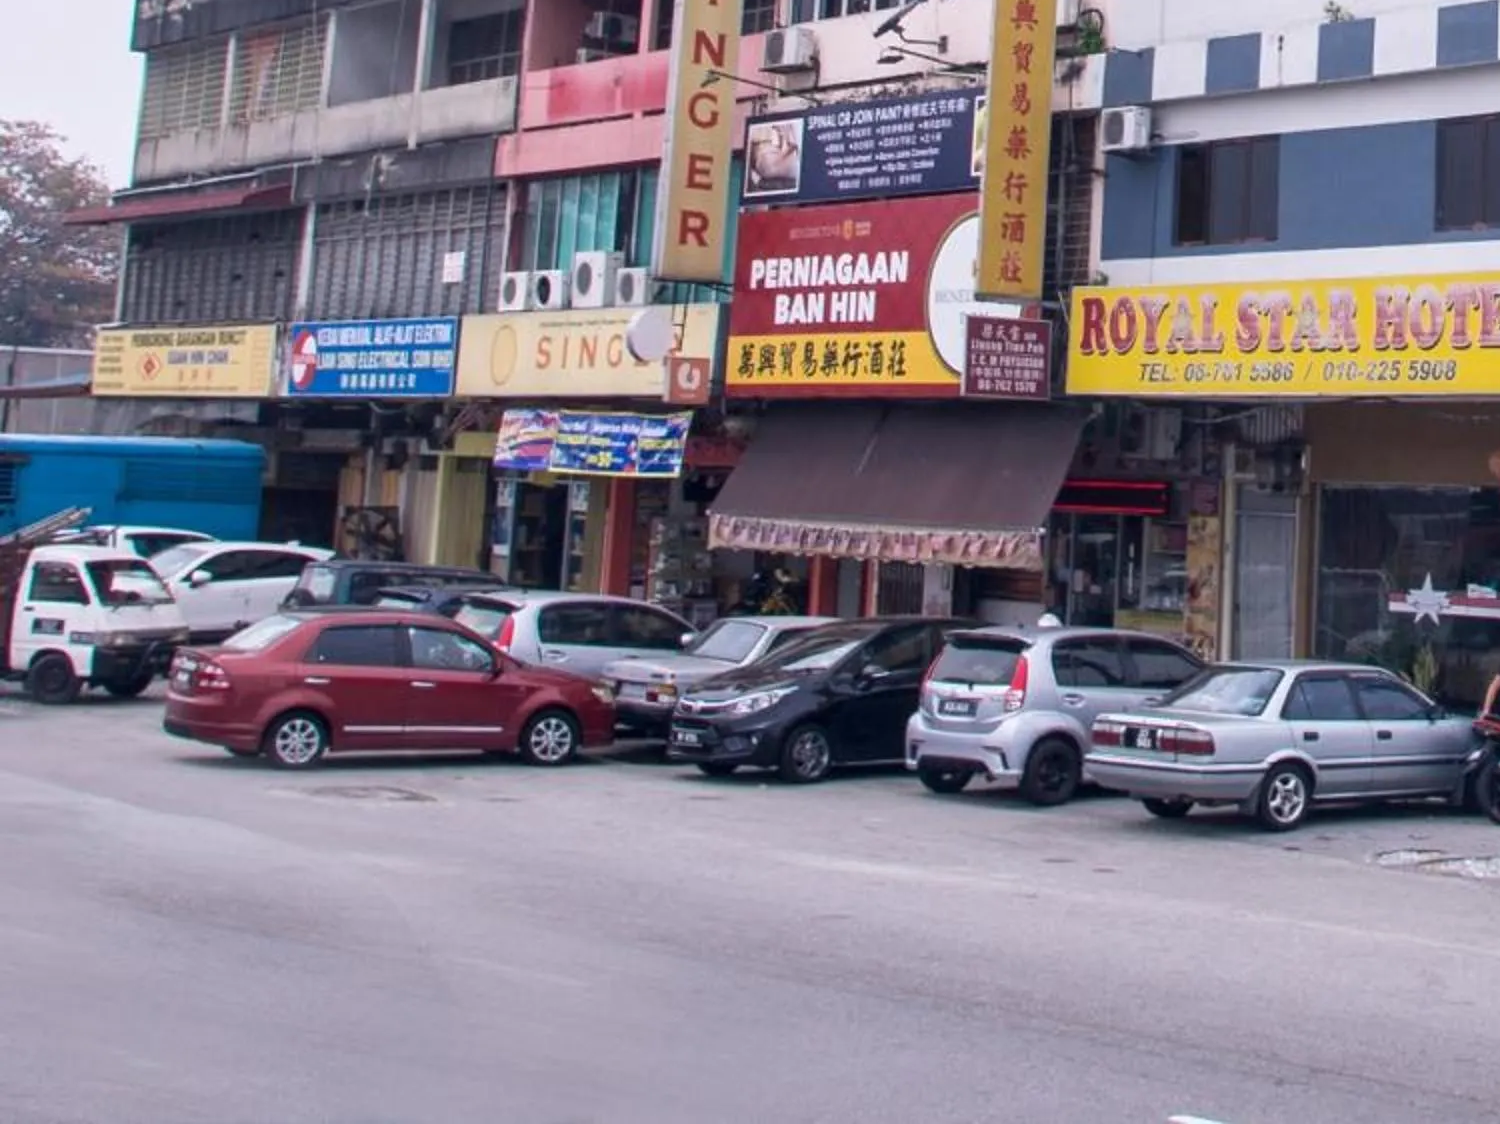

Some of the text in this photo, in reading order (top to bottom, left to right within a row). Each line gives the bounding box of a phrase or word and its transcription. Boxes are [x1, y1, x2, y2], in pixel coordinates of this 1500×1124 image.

[807, 112, 837, 130] SPINAL
[750, 250, 909, 289] PERNIAGAAN
[774, 290, 876, 325] BAN HIN
[1079, 289, 1225, 356] ROYAL
[1235, 285, 1362, 354] STAR
[536, 332, 682, 369] SING
